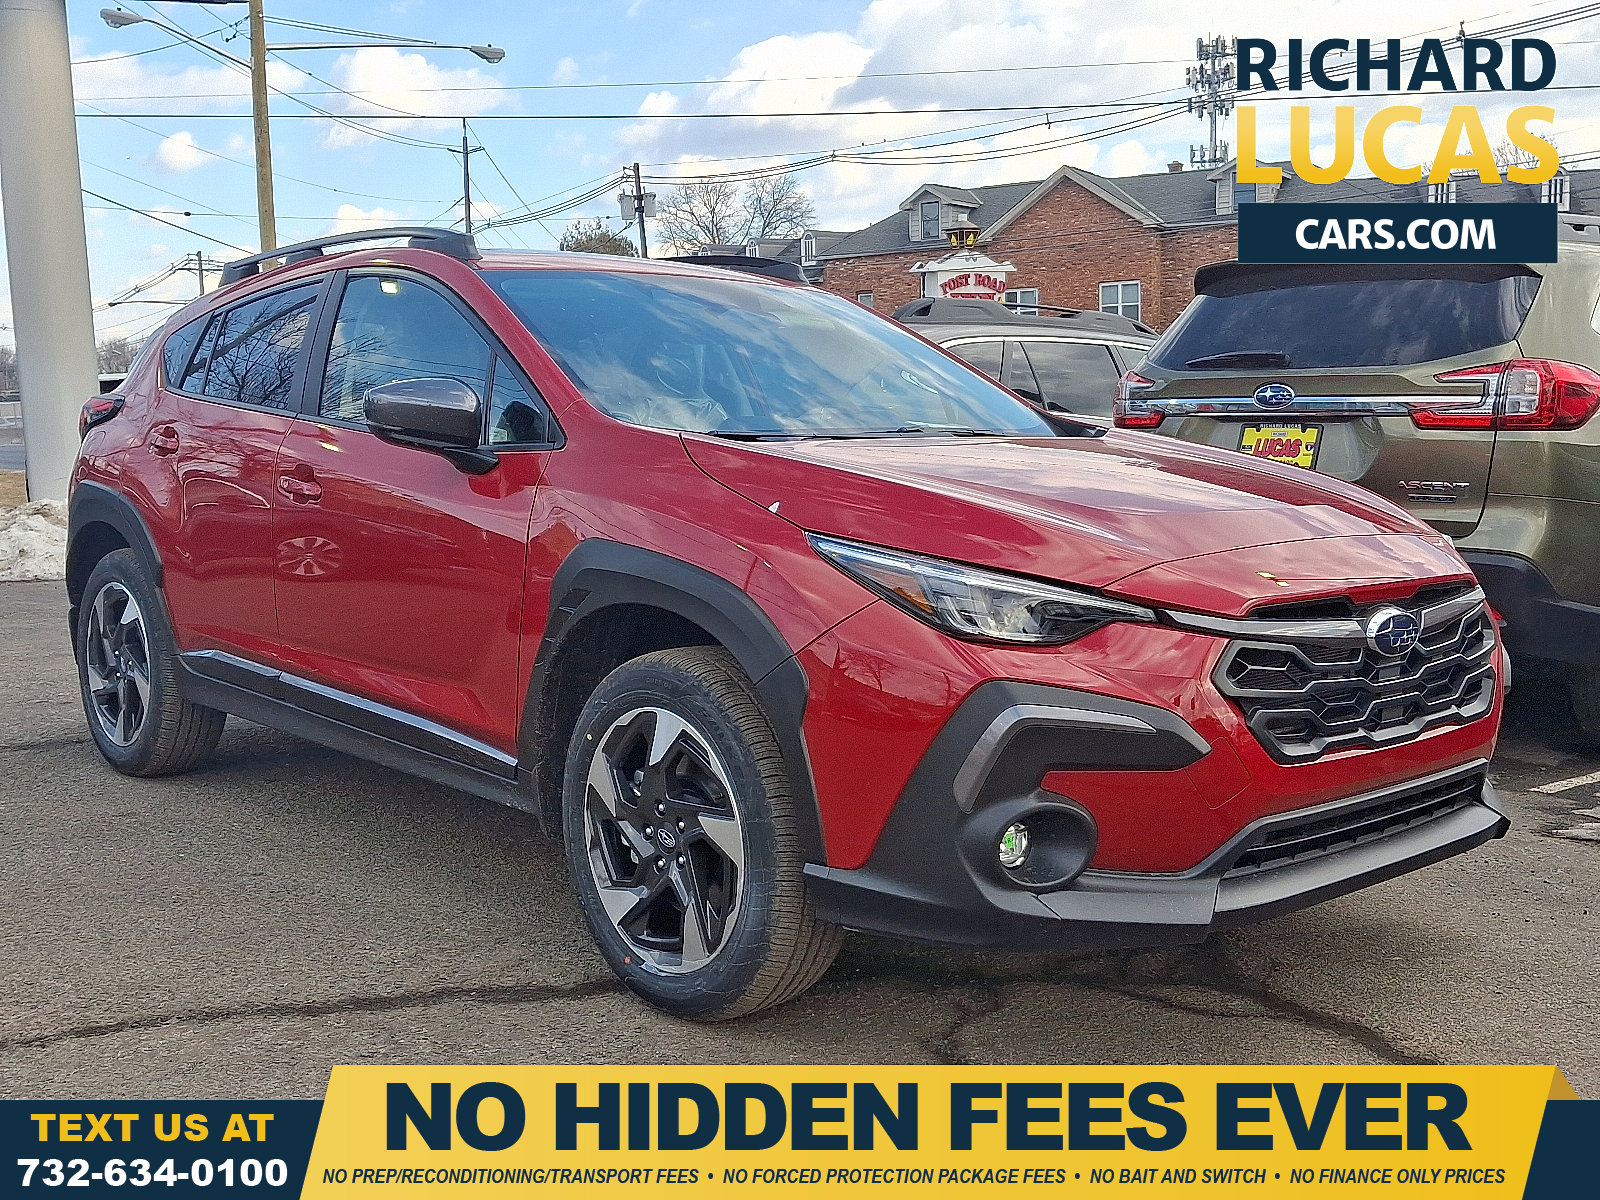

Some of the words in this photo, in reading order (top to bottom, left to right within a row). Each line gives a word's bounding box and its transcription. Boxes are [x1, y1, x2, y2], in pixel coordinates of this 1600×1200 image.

[940, 273, 971, 295] POST
[974, 273, 1008, 294] ROAD
[1253, 437, 1303, 458] LUCAS
[1397, 480, 1470, 492] ASCENT
